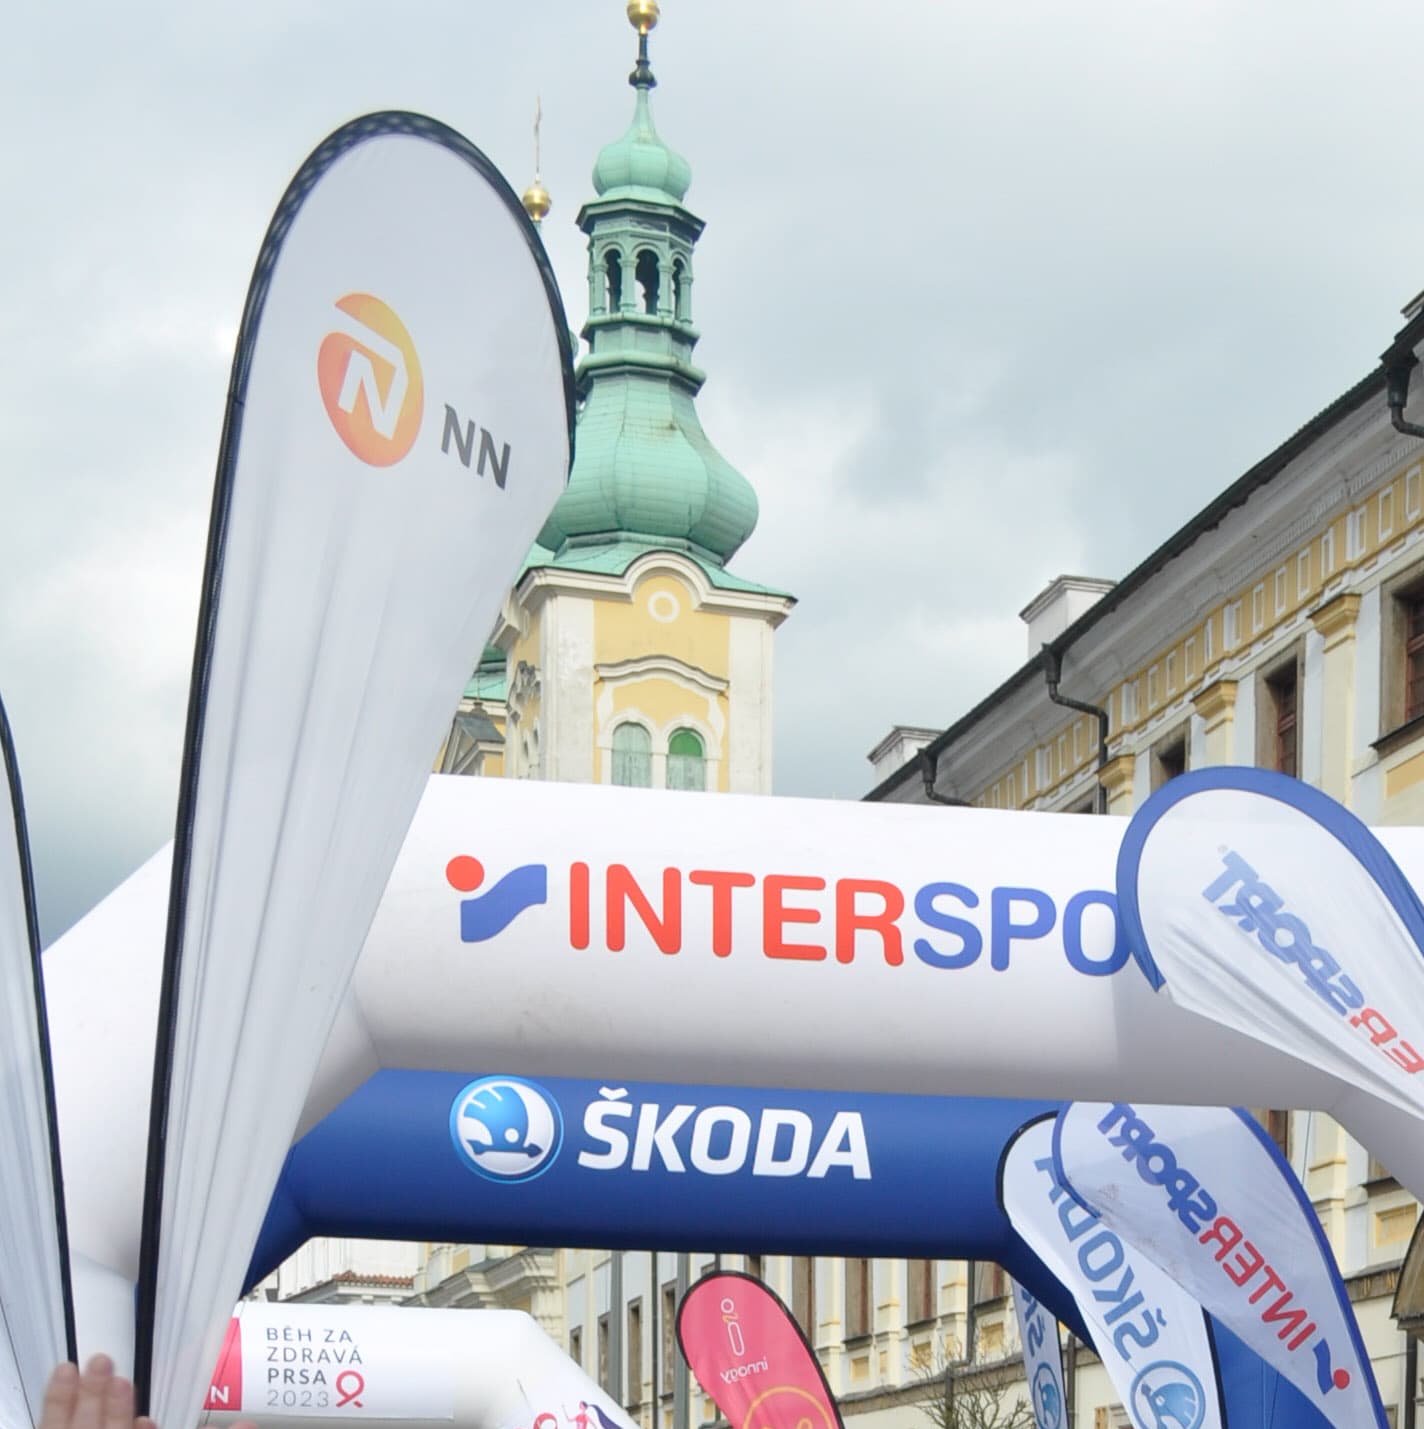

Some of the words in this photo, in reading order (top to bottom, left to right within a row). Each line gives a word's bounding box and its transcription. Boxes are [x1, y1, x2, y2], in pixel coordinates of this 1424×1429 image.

[440, 402, 512, 491] NN
[569, 861, 1132, 977] INTERSPO
[577, 1087, 872, 1180] ŠKODA
[324, 1328, 352, 1343] ZA
[267, 1345, 363, 1365] ZDRAVÁ
[267, 1367, 327, 1385] PRSA
[267, 1389, 330, 1408] 2023
